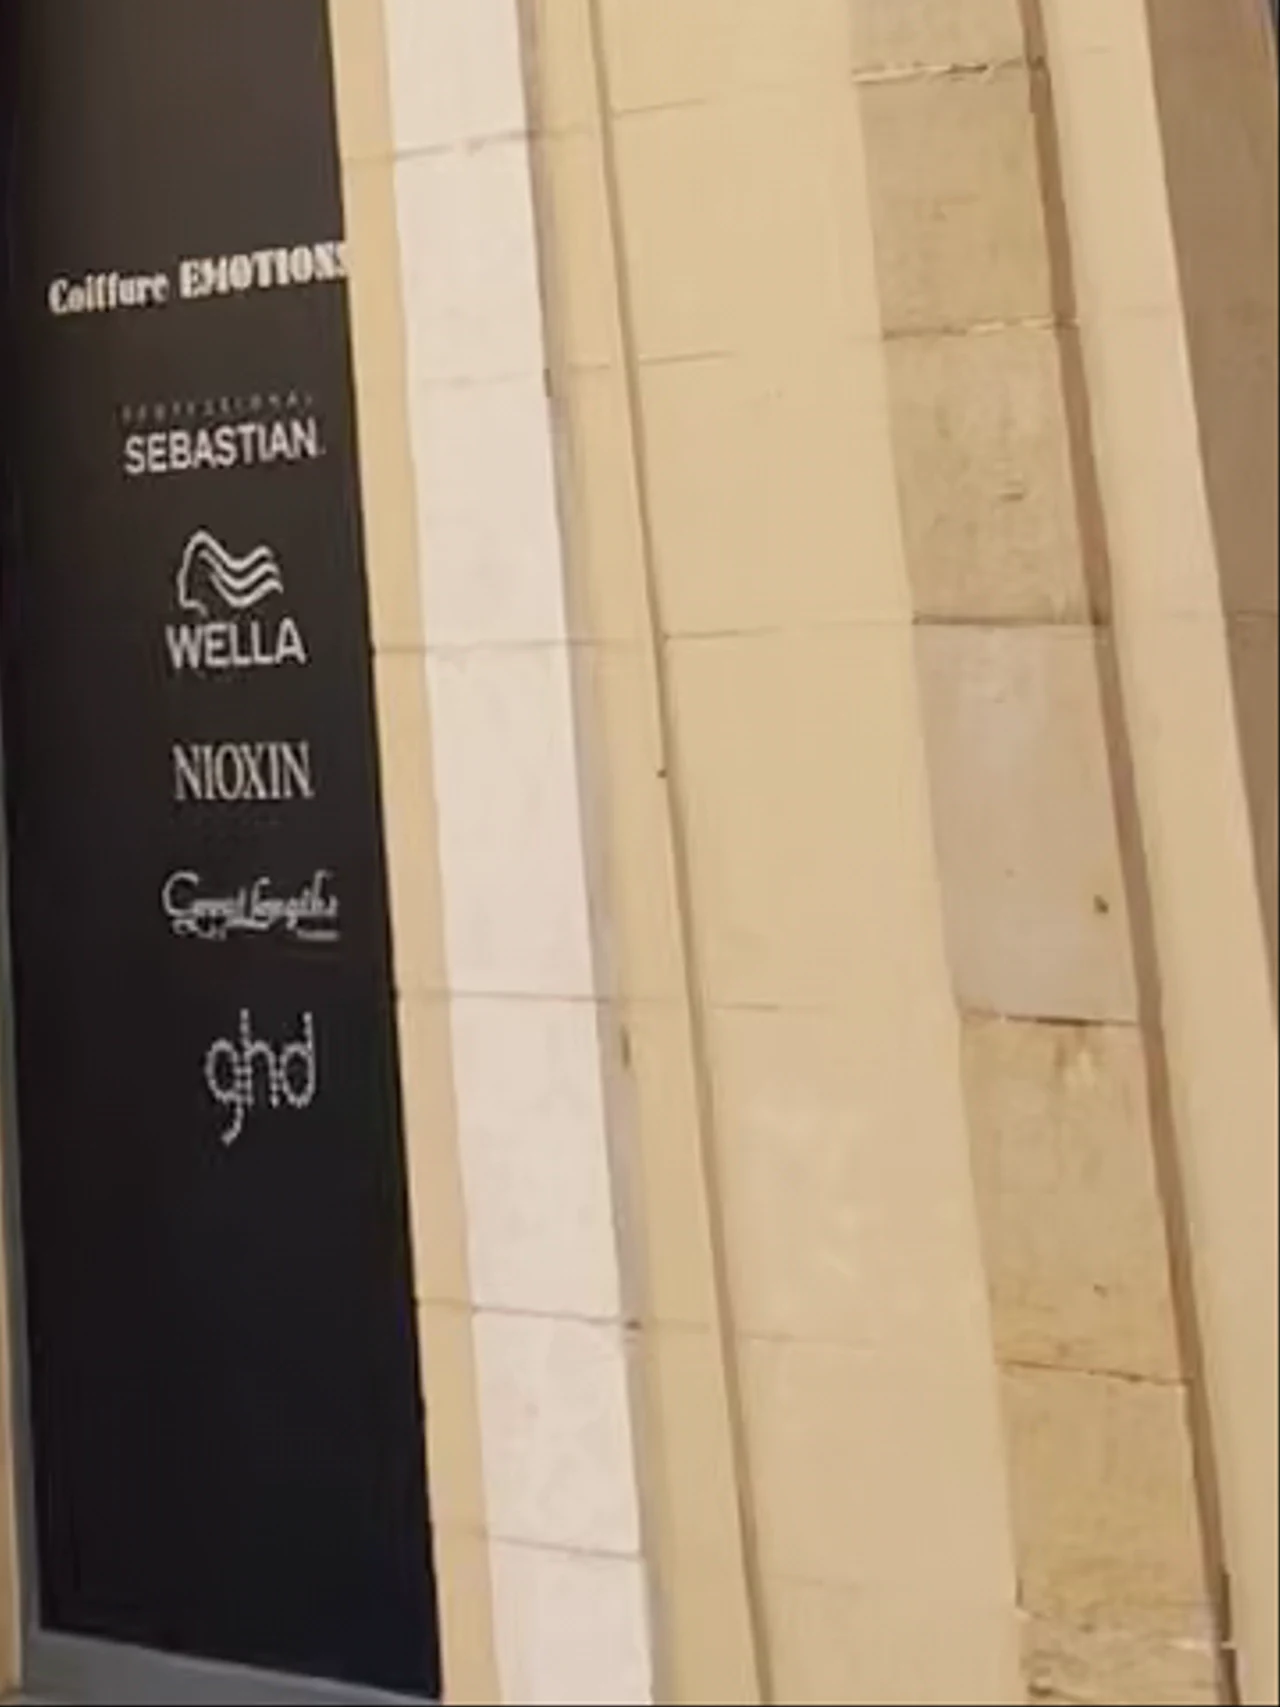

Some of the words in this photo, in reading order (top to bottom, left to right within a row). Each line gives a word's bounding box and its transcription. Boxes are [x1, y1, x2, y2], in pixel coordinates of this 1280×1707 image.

[48, 272, 169, 314] Coiffure
[124, 417, 319, 474] SEBASTIAN
[165, 617, 308, 669] WELLA
[172, 741, 315, 800] NIOXIN
[205, 1008, 316, 1146] ghd
